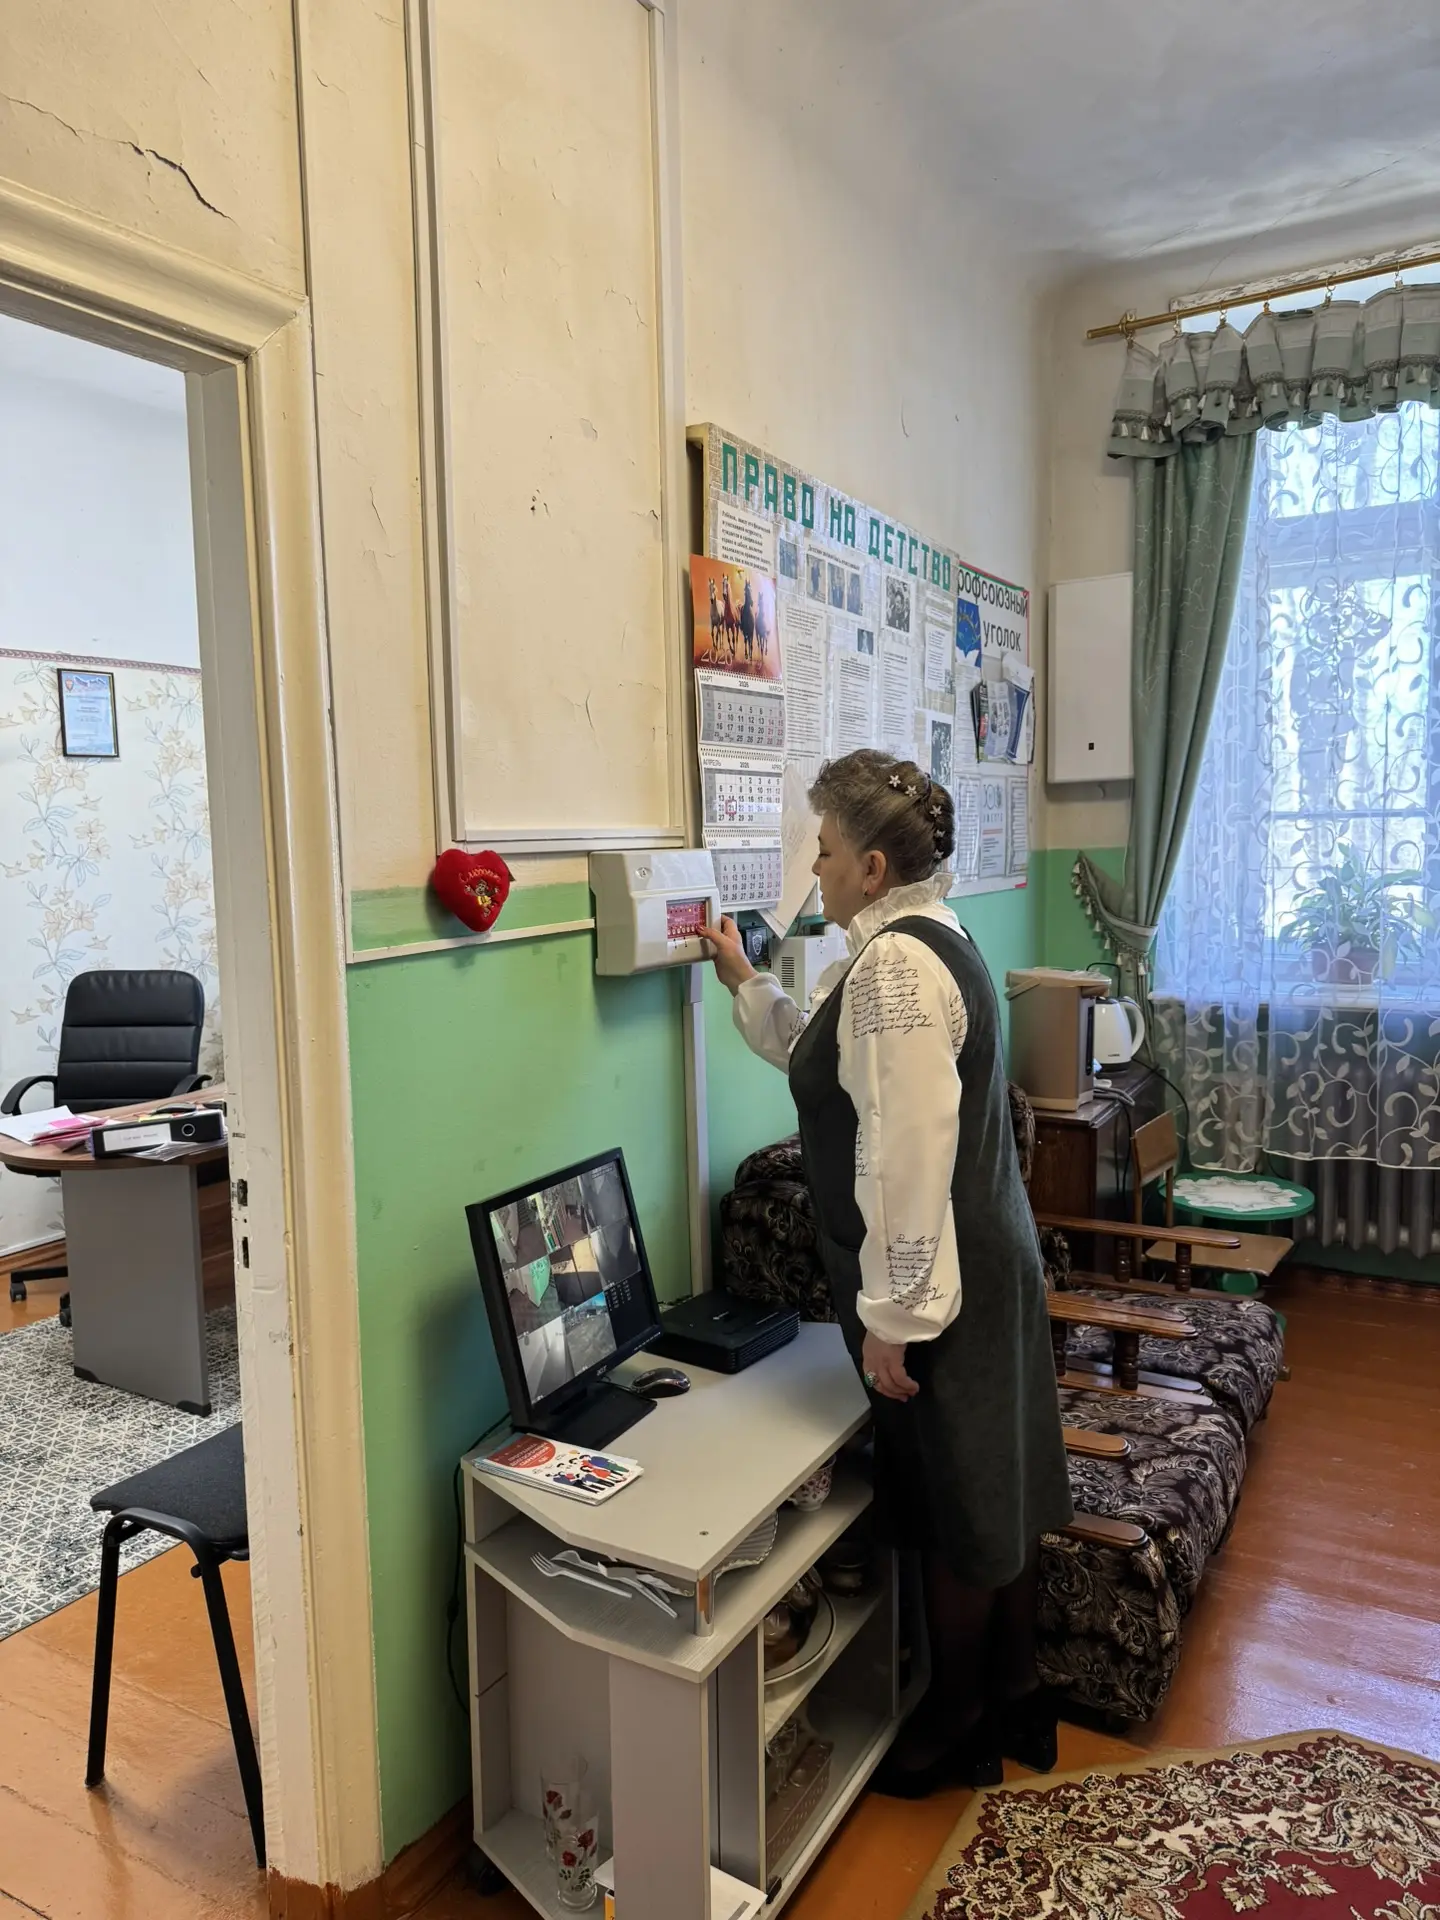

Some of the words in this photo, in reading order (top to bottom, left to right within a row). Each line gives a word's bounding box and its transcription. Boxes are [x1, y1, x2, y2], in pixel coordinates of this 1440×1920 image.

[721, 442, 814, 529] ПРАВО
[830, 496, 856, 549] НА
[868, 516, 951, 592] ДЕТСТВО
[957, 569, 1028, 619] рофсоюзный
[769, 685, 783, 693] MARCH
